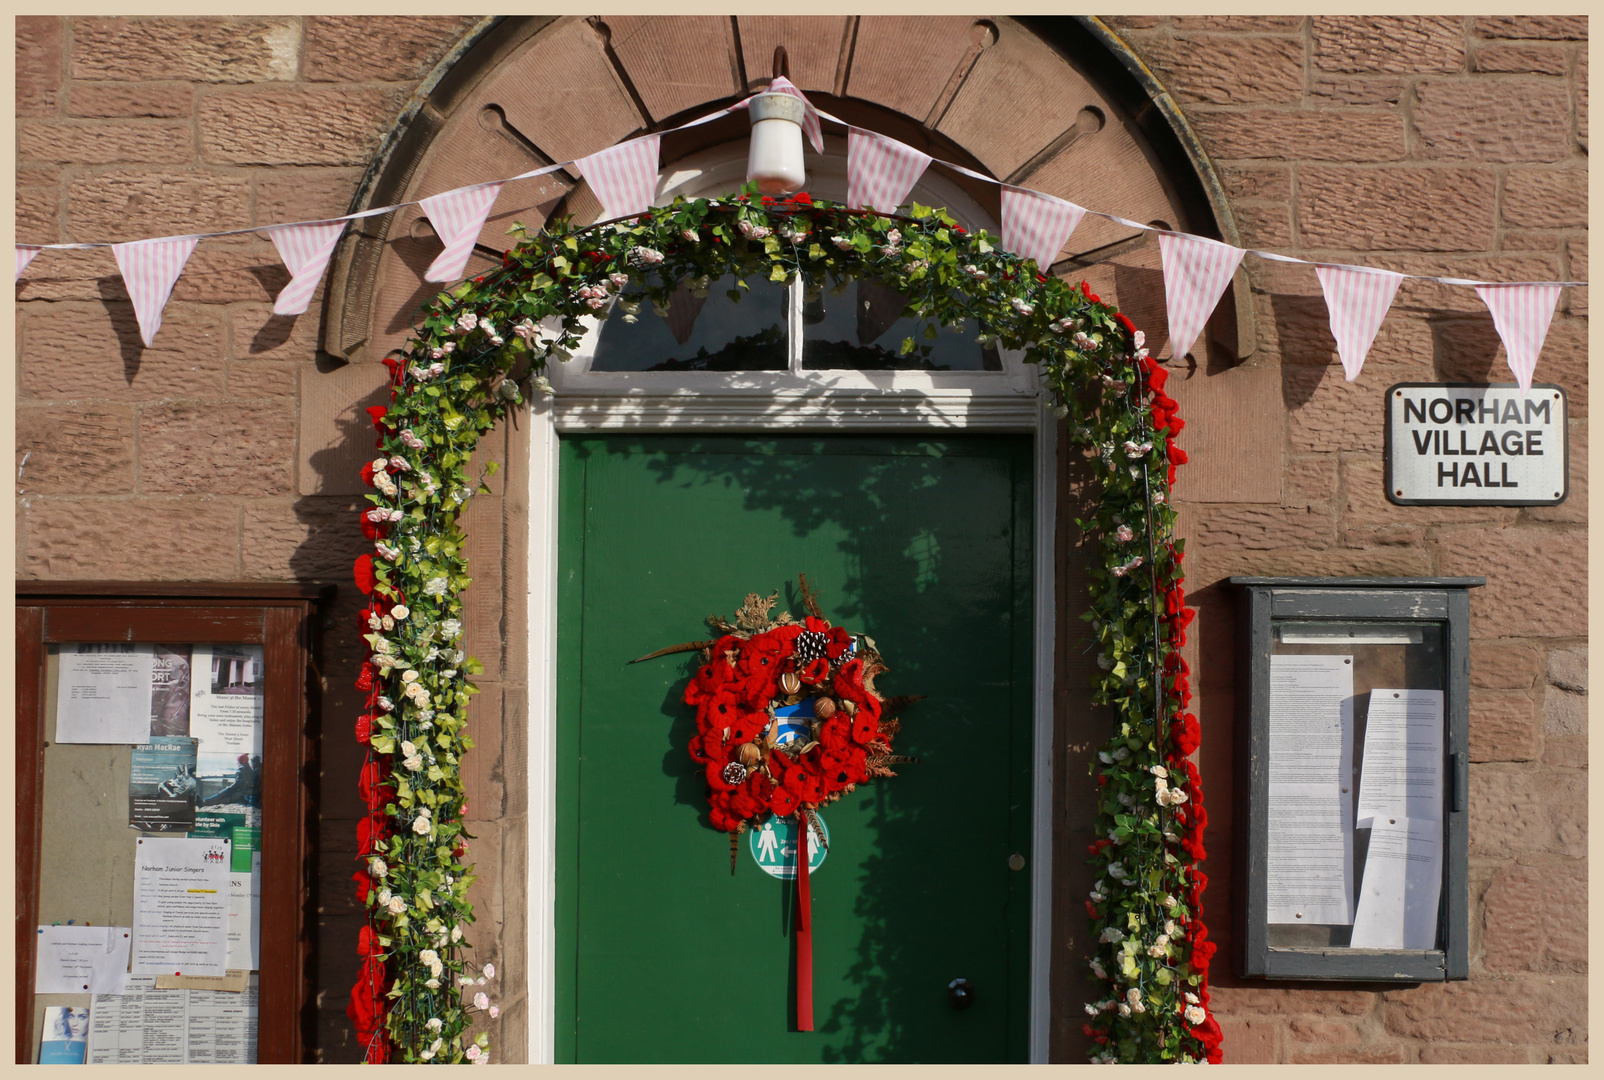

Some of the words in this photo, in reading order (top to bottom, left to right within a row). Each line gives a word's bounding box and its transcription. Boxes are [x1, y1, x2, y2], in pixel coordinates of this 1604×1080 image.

[1404, 398, 1550, 424] NORHAM
[1412, 430, 1544, 456] VILLAGE
[1437, 462, 1518, 488] HALL
[184, 866, 204, 874] Singers
